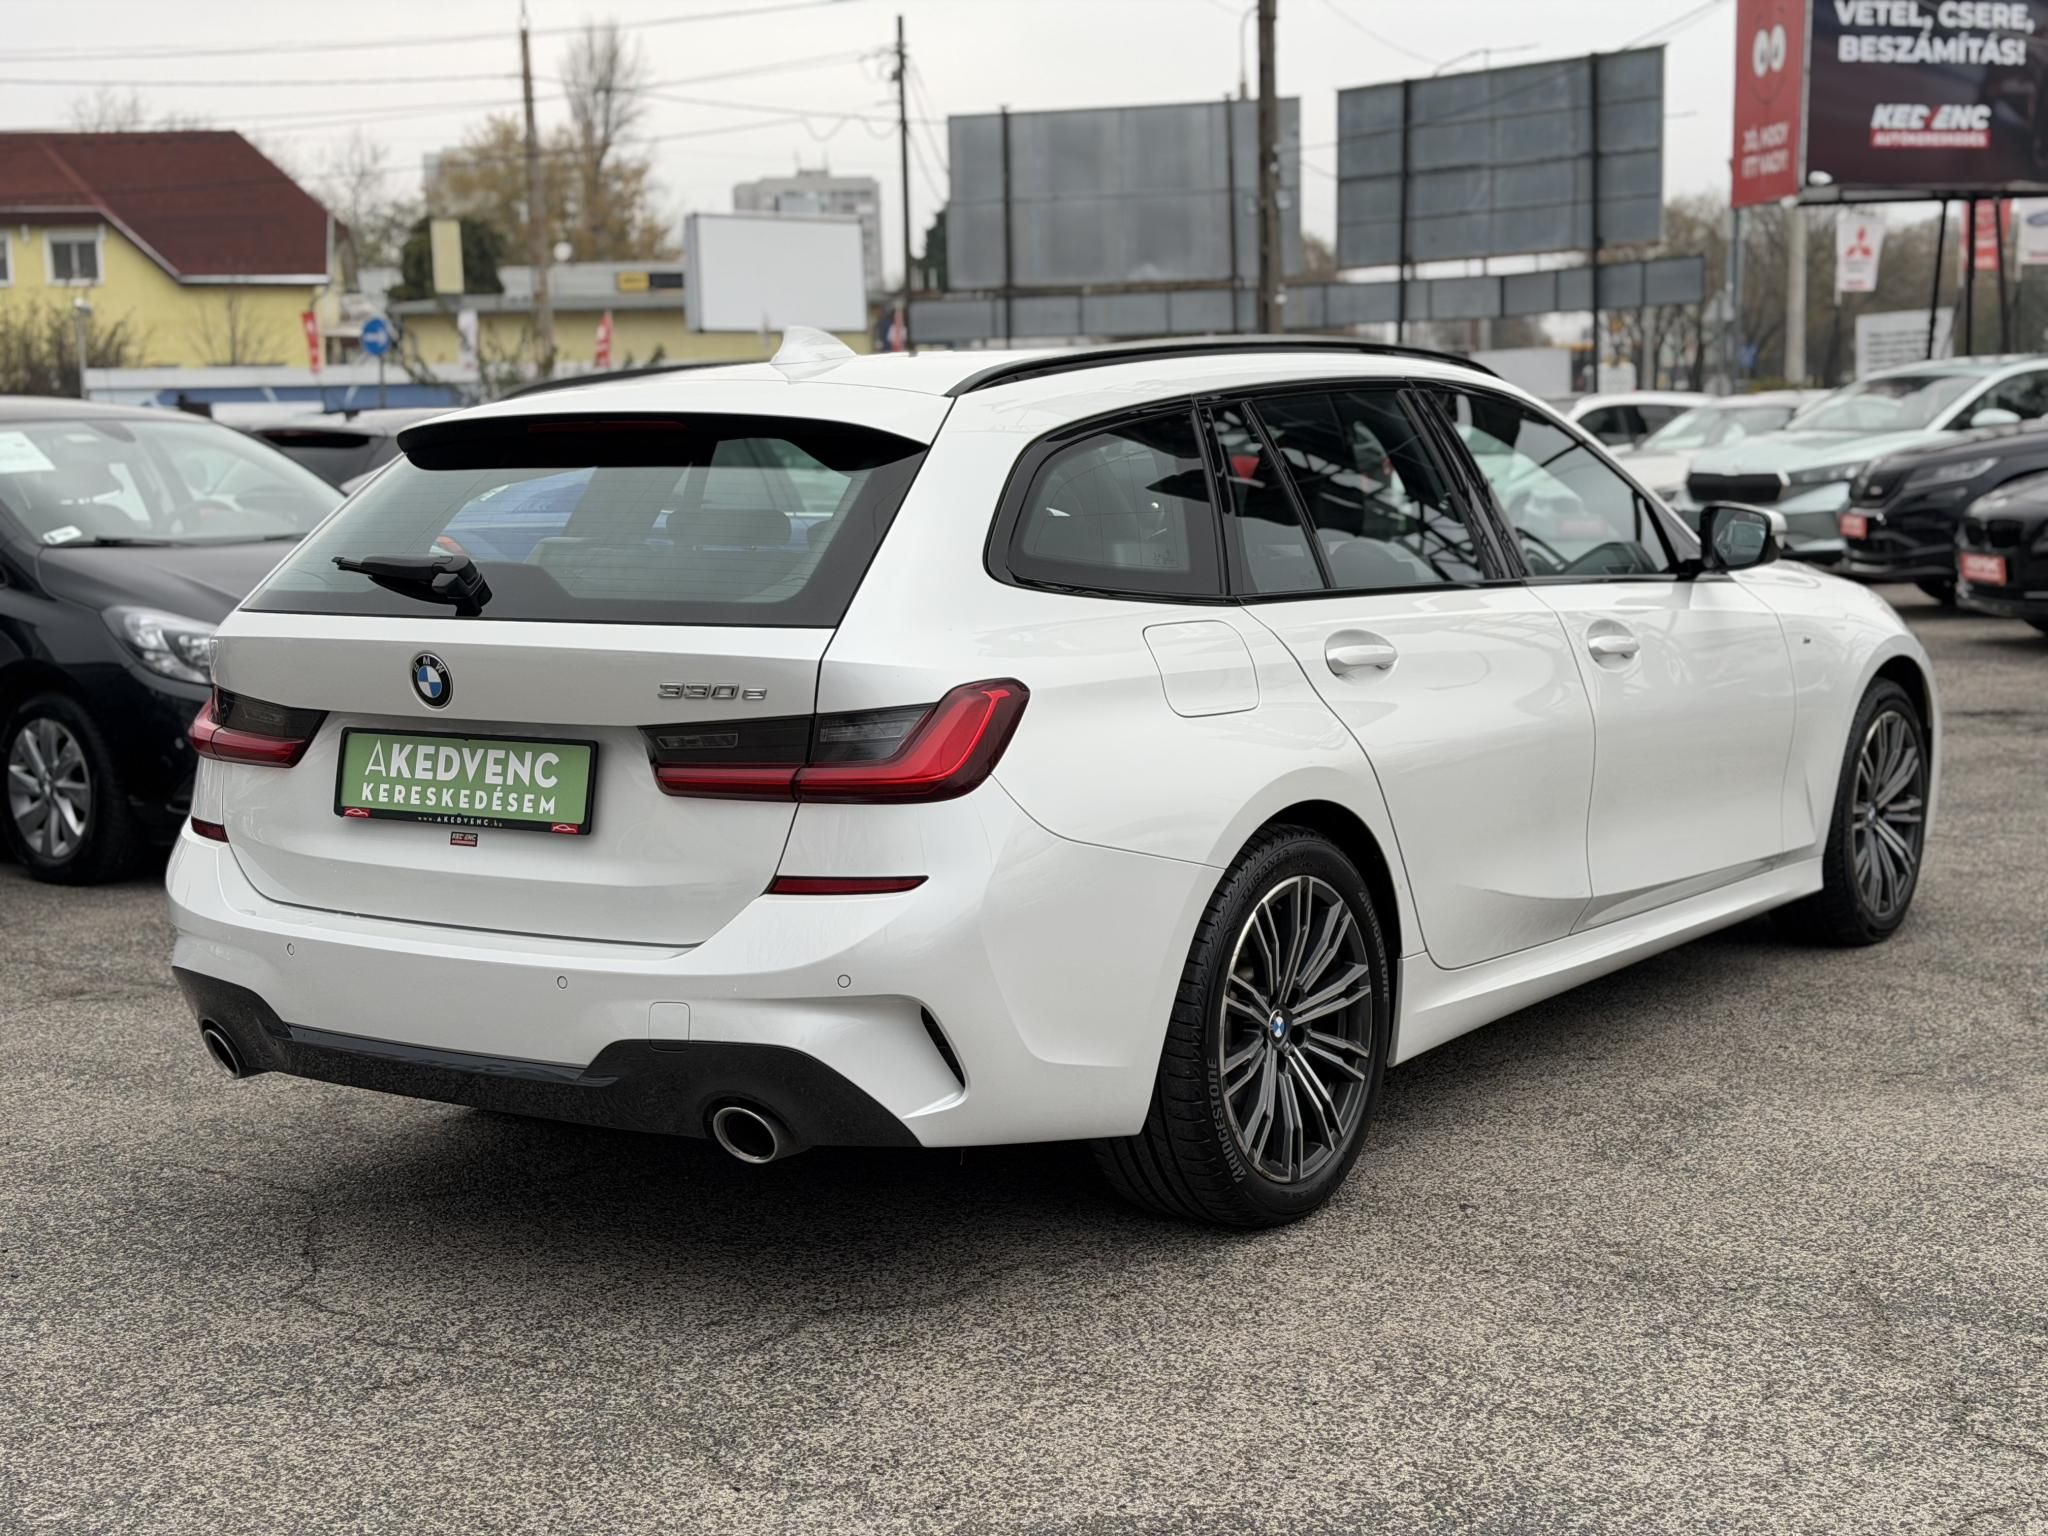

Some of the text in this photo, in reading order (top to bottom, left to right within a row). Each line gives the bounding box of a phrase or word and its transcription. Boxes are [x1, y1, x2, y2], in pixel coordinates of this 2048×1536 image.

[1938, 1, 2035, 34] CSERE,
[1838, 31, 2026, 65] BESZÁMÍTÁS!
[413, 656, 445, 675] BMW
[361, 782, 556, 815] KERESKEDÉSEM
[1207, 1057, 1248, 1183] BRIDGESTONE
